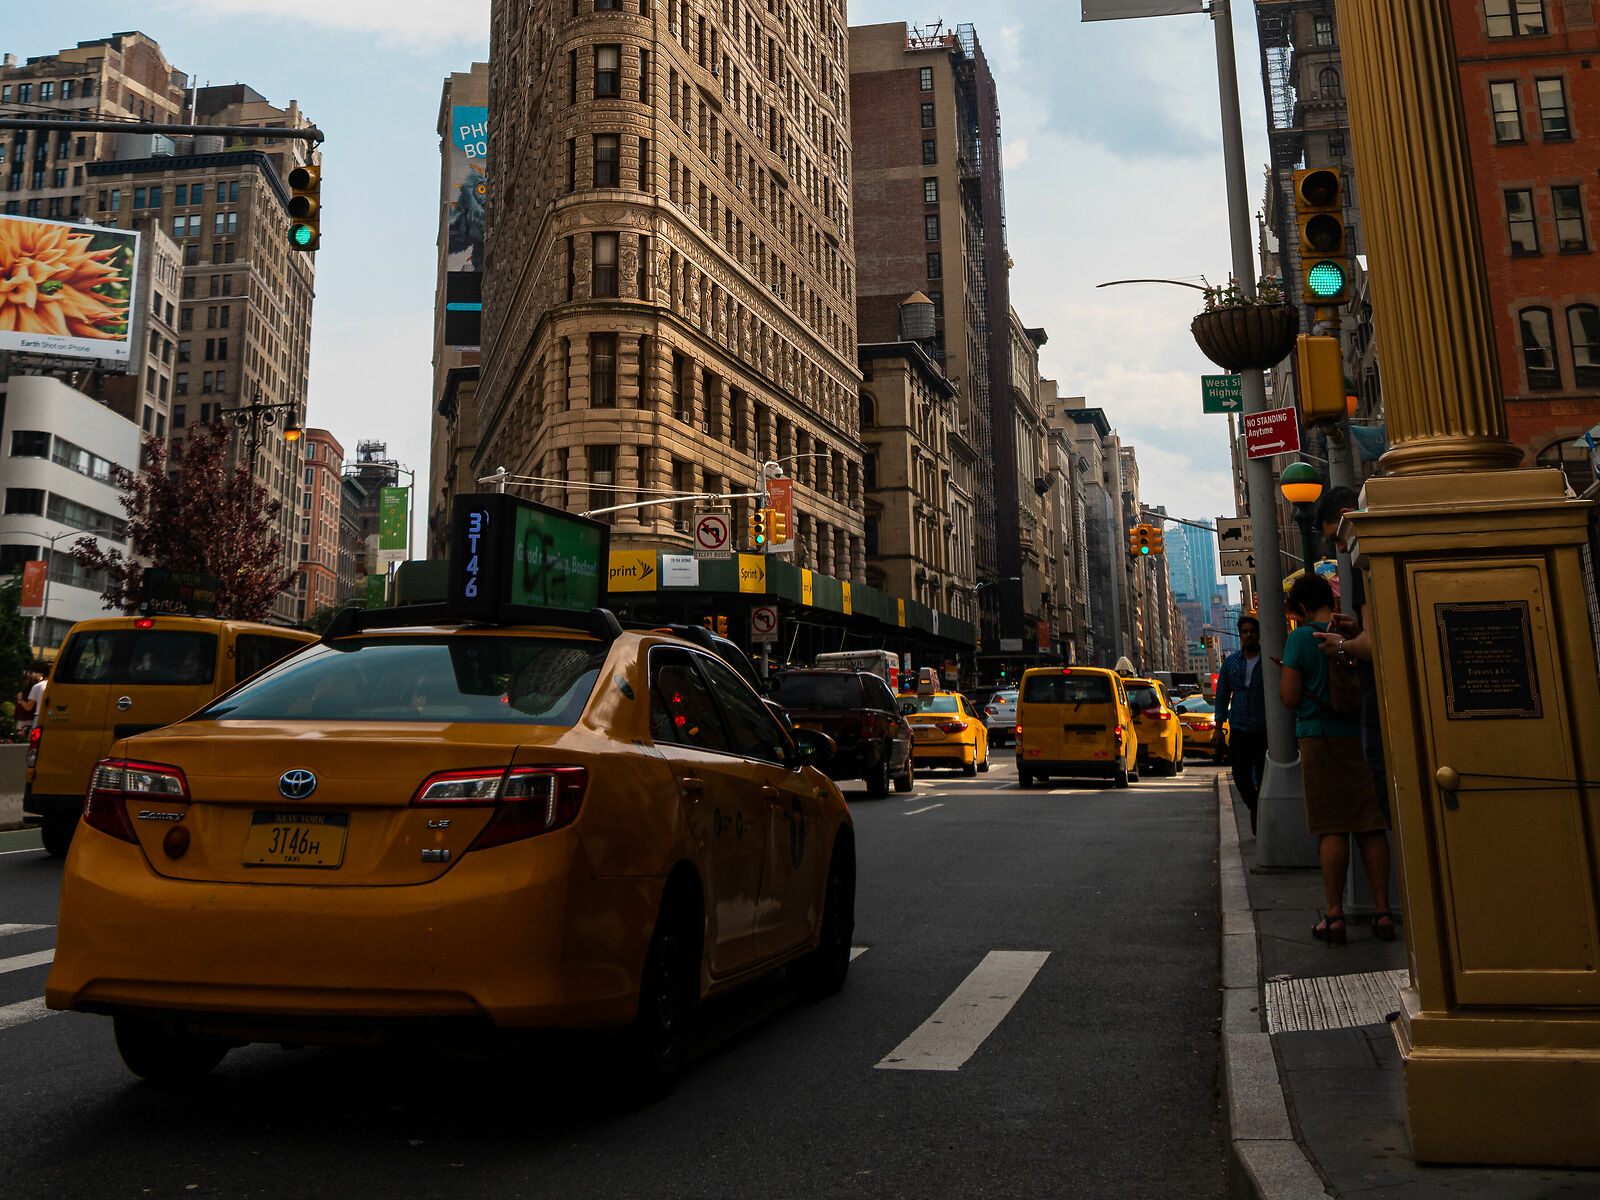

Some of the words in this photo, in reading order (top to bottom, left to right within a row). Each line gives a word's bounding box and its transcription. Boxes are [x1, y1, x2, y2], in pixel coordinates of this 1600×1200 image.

[21, 340, 40, 348] Earth
[1205, 379, 1229, 387] West
[1246, 419, 1256, 428] NO
[1257, 413, 1287, 426] STANDING
[1248, 426, 1273, 438] Anytime
[465, 512, 482, 598] 3T46
[740, 568, 757, 581] Sprint
[275, 813, 297, 823] NEW
[299, 814, 326, 824] YORK
